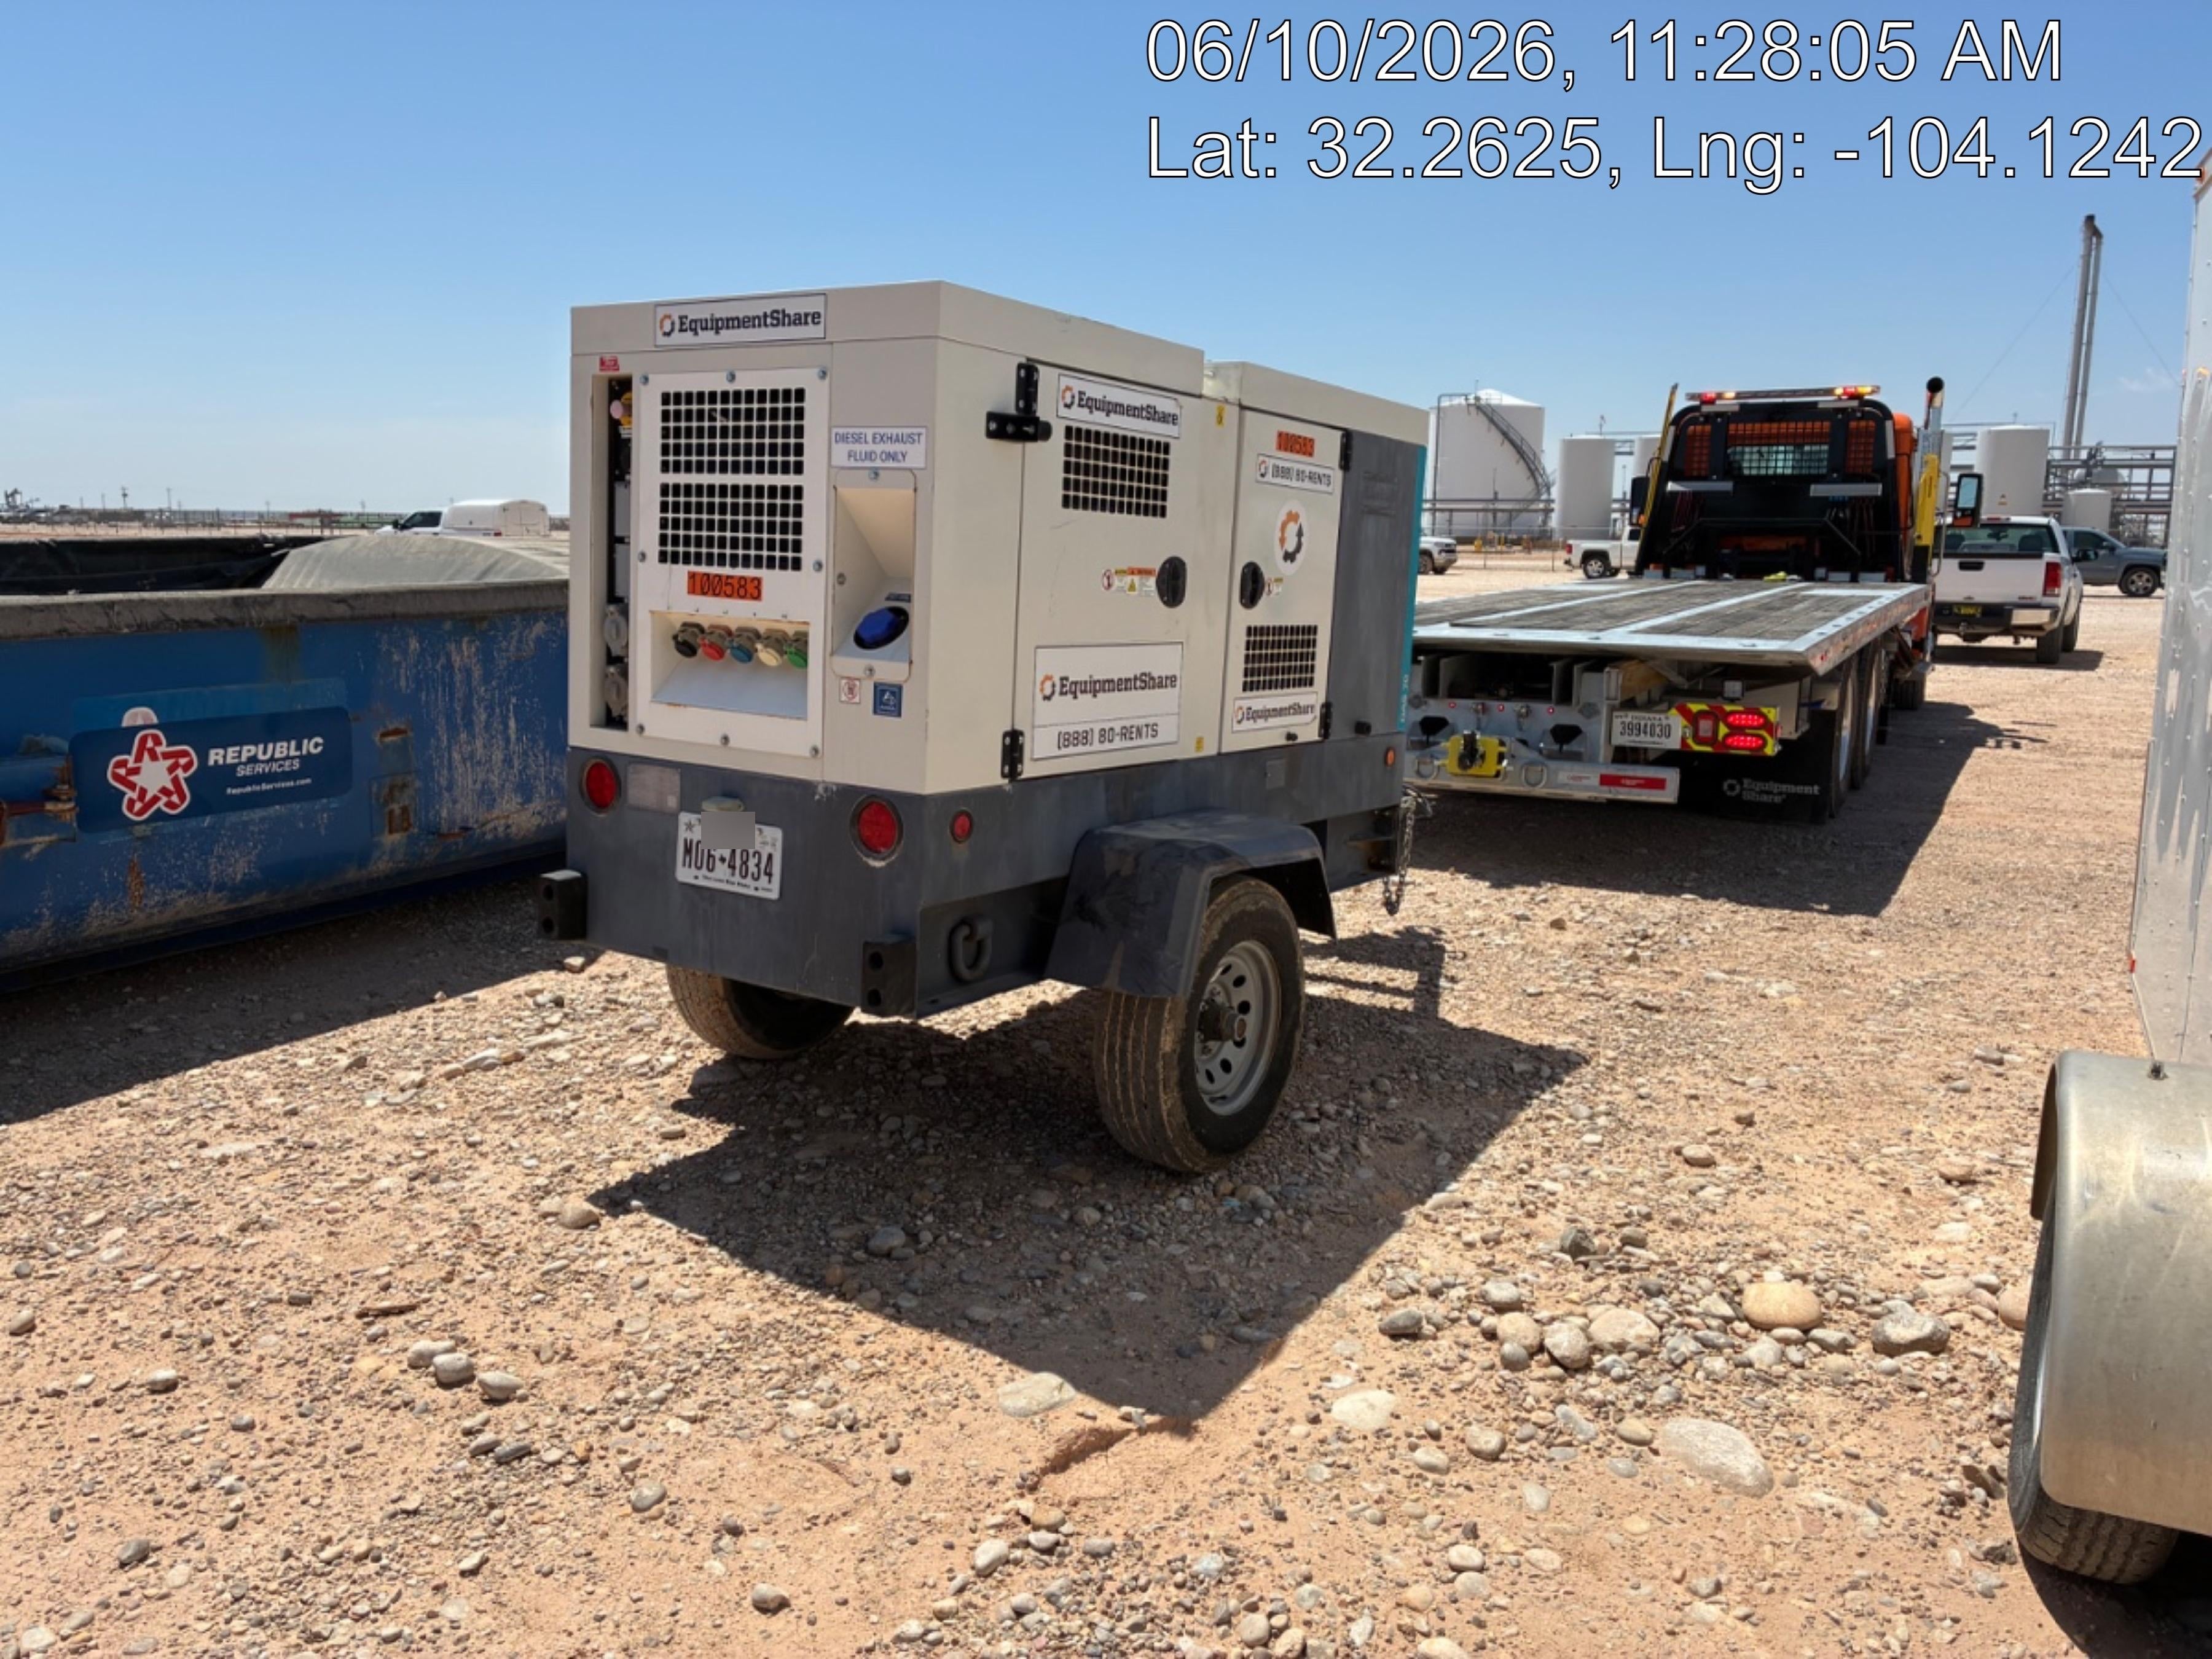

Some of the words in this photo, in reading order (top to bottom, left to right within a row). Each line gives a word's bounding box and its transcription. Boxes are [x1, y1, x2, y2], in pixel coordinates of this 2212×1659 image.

[678, 308, 821, 336] EquipmentShare
[1077, 390, 1179, 426] EquipmentShare
[834, 432, 869, 444] DIESEL
[872, 432, 922, 445] EXHAUST
[847, 449, 877, 461] FLUID
[879, 450, 908, 462] ONLY
[688, 571, 761, 600] 100583
[1059, 671, 1177, 700] EquipmentShare
[1057, 728, 1094, 750] (888)
[1098, 723, 1158, 744] 80-RENTS
[208, 737, 324, 766] REPUBLIC
[236, 758, 300, 777] SERVICES
